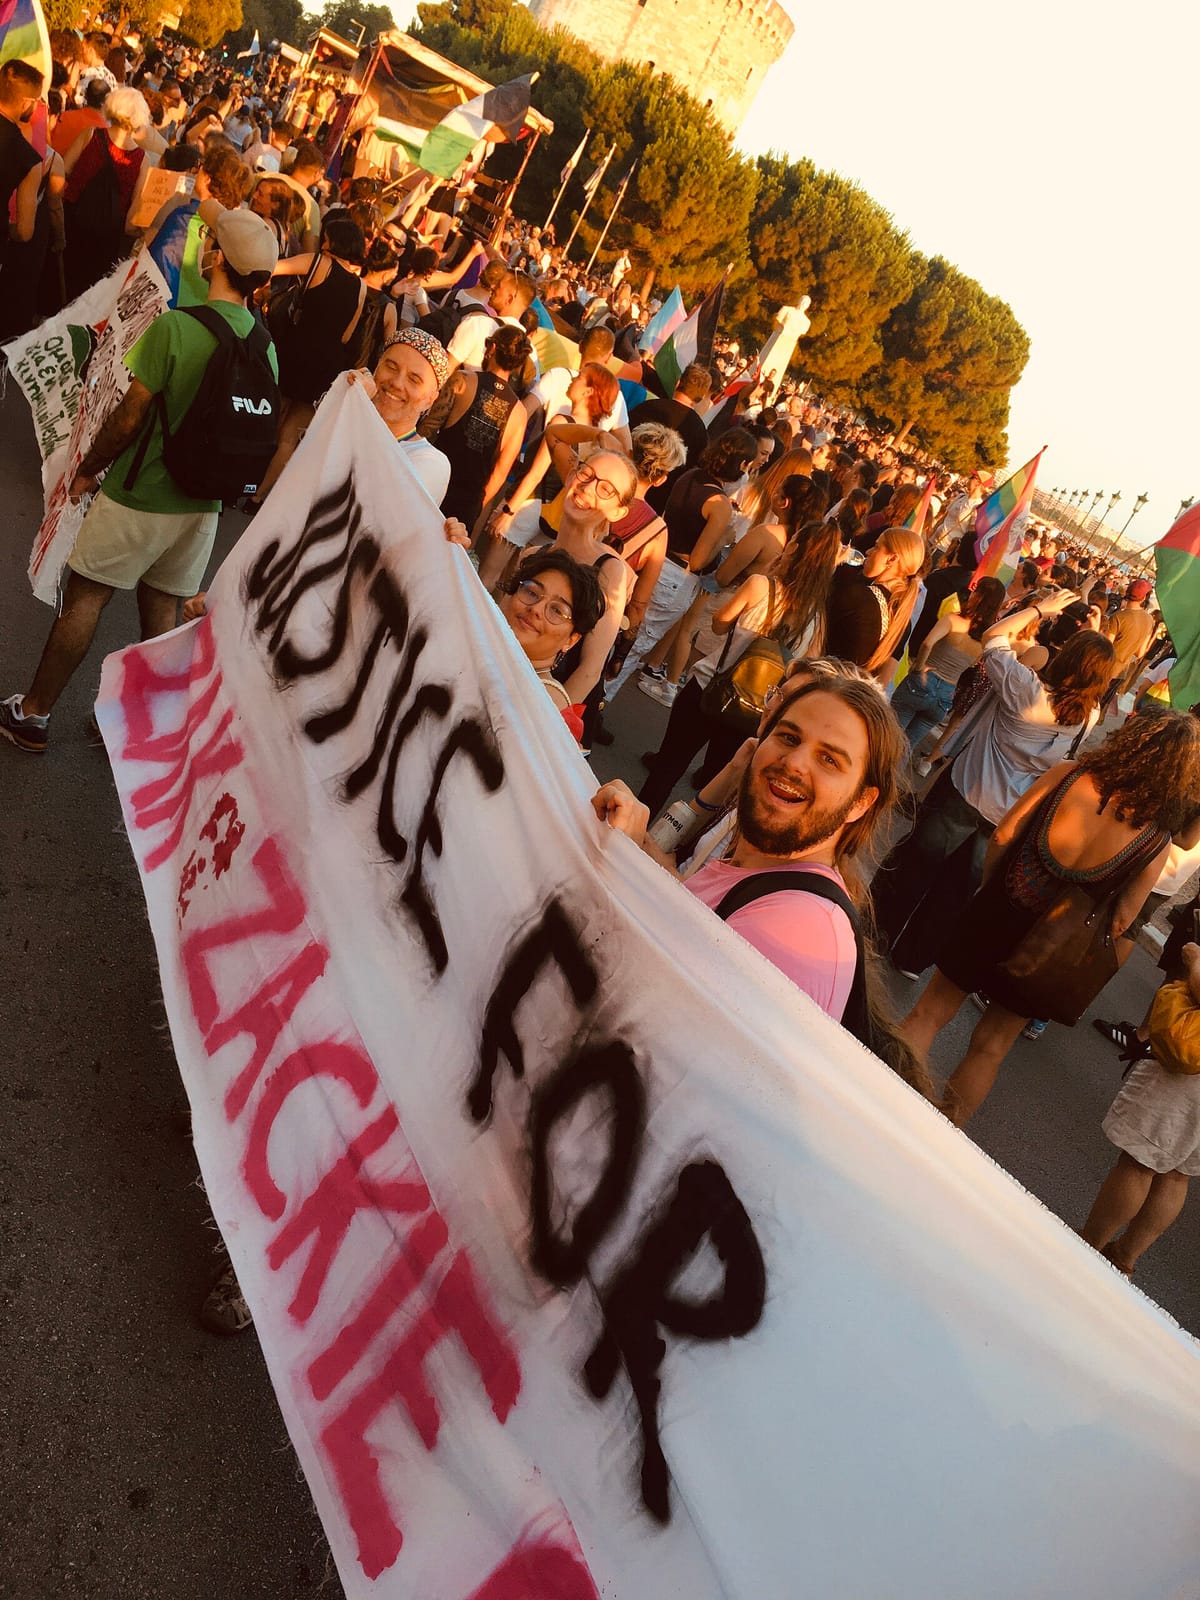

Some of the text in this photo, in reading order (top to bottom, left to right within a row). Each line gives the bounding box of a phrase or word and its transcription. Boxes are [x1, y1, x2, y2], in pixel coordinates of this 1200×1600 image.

[231, 395, 272, 415] FILA
[182, 836, 522, 1580] ZACKIE
[243, 472, 505, 976] JUSTICE
[467, 898, 766, 1527] FOR
